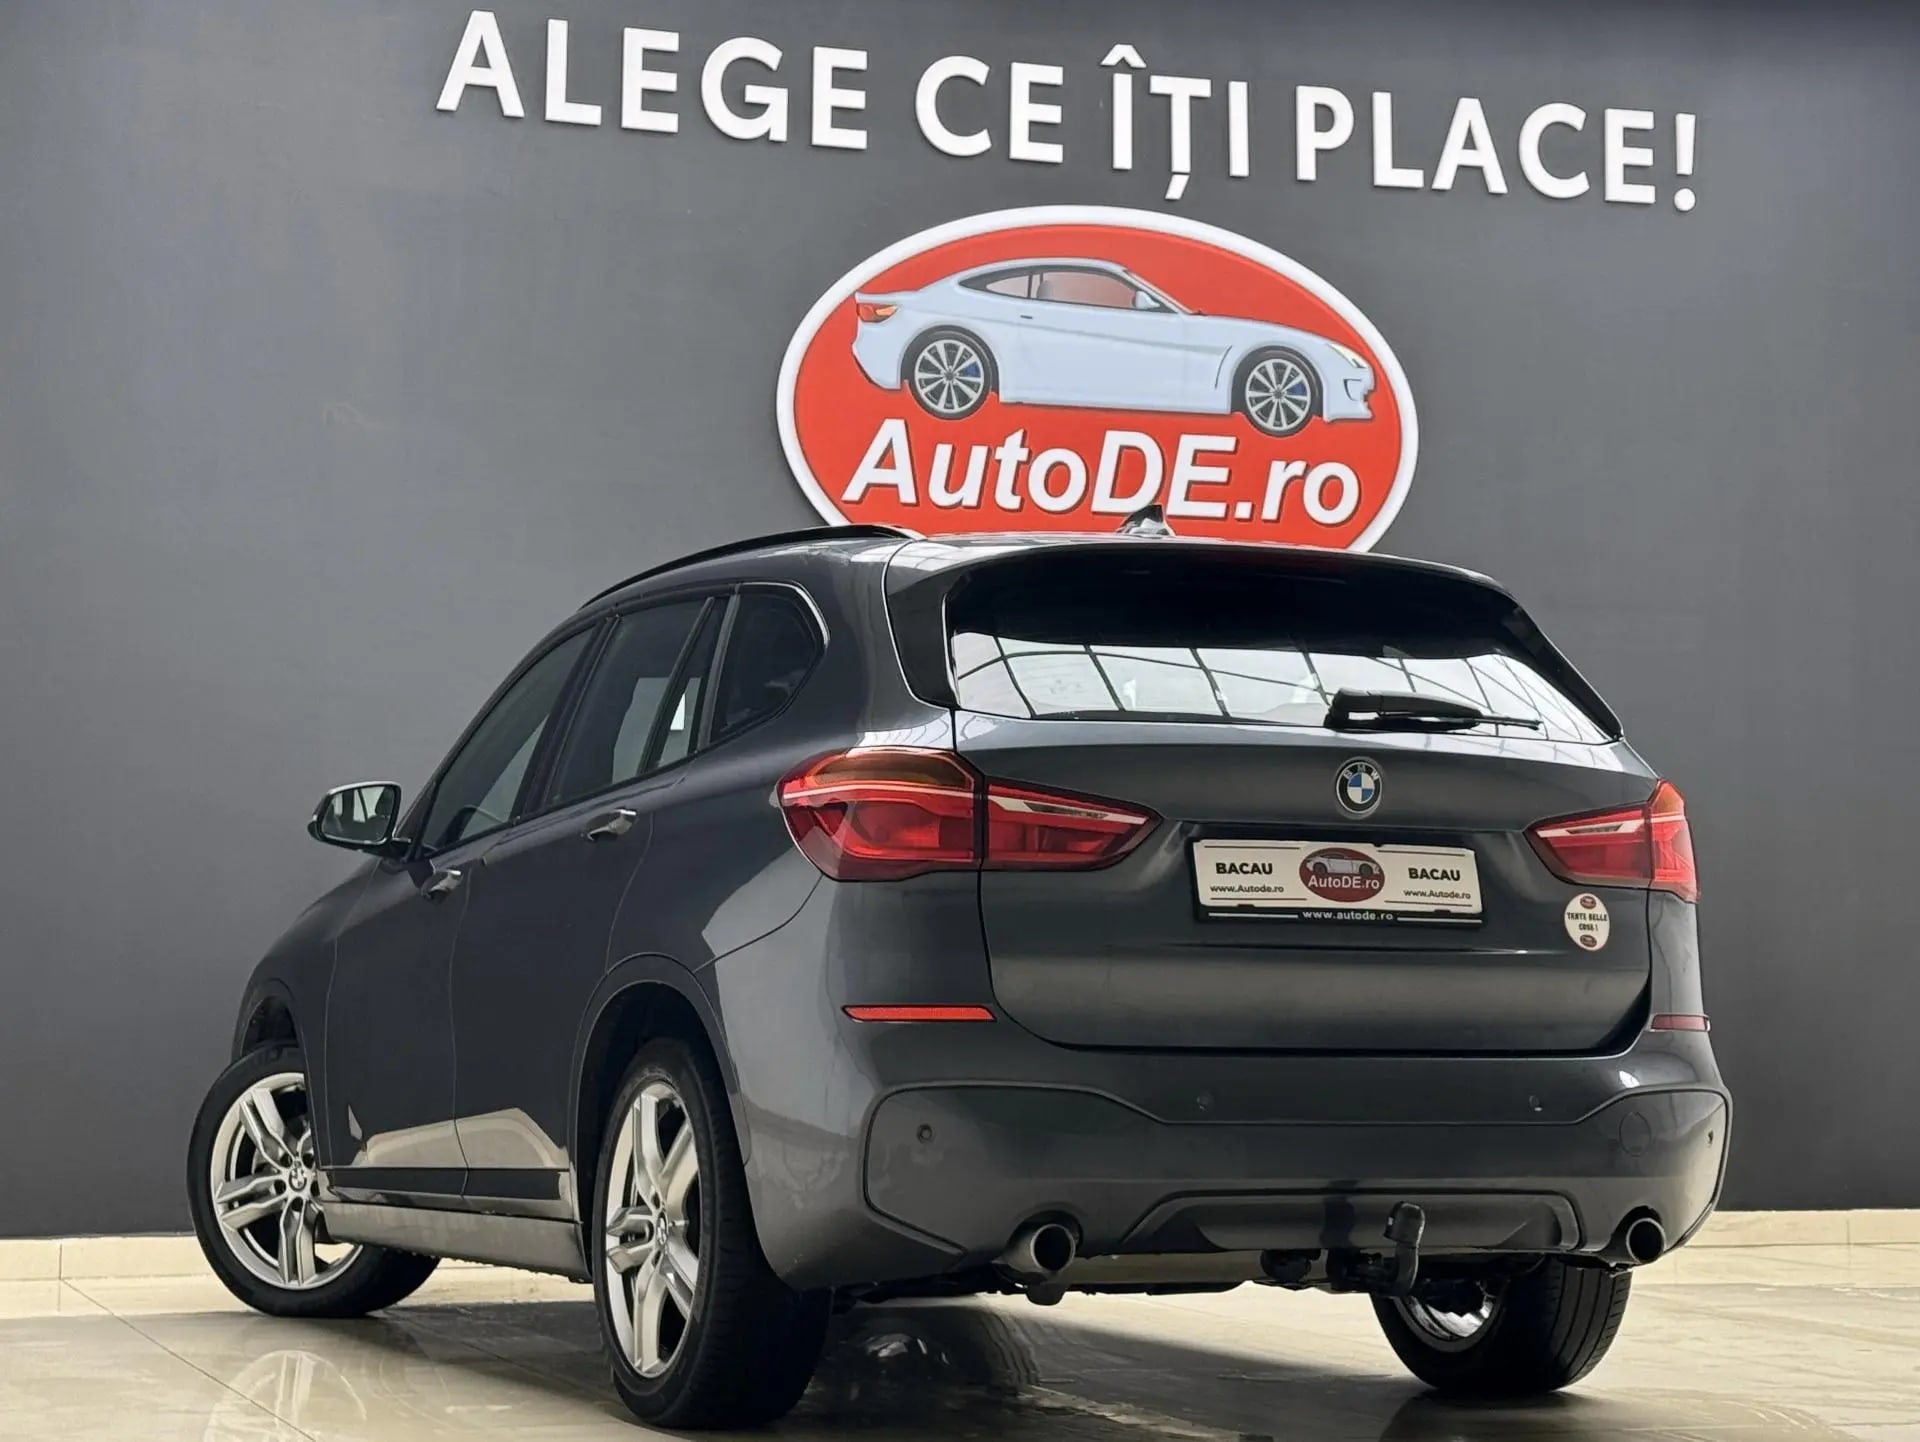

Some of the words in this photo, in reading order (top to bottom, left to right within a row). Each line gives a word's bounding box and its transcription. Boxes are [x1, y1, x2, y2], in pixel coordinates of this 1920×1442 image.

[437, 10, 868, 150] ALEGE
[916, 56, 1063, 163] CE
[1102, 44, 1250, 200] ÎȚI
[1297, 86, 1696, 211] PLACE!
[842, 419, 1361, 525] AutoDE.ro
[1343, 764, 1380, 780] BMW
[1215, 862, 1273, 876] BACAU
[1408, 867, 1461, 882] BACAU
[1210, 884, 1284, 894] www.Autode.ro
[1308, 874, 1380, 890] AutoDE.ro
[1403, 889, 1471, 900] www.Autode.ro
[1302, 910, 1393, 921] www.autode.ro
